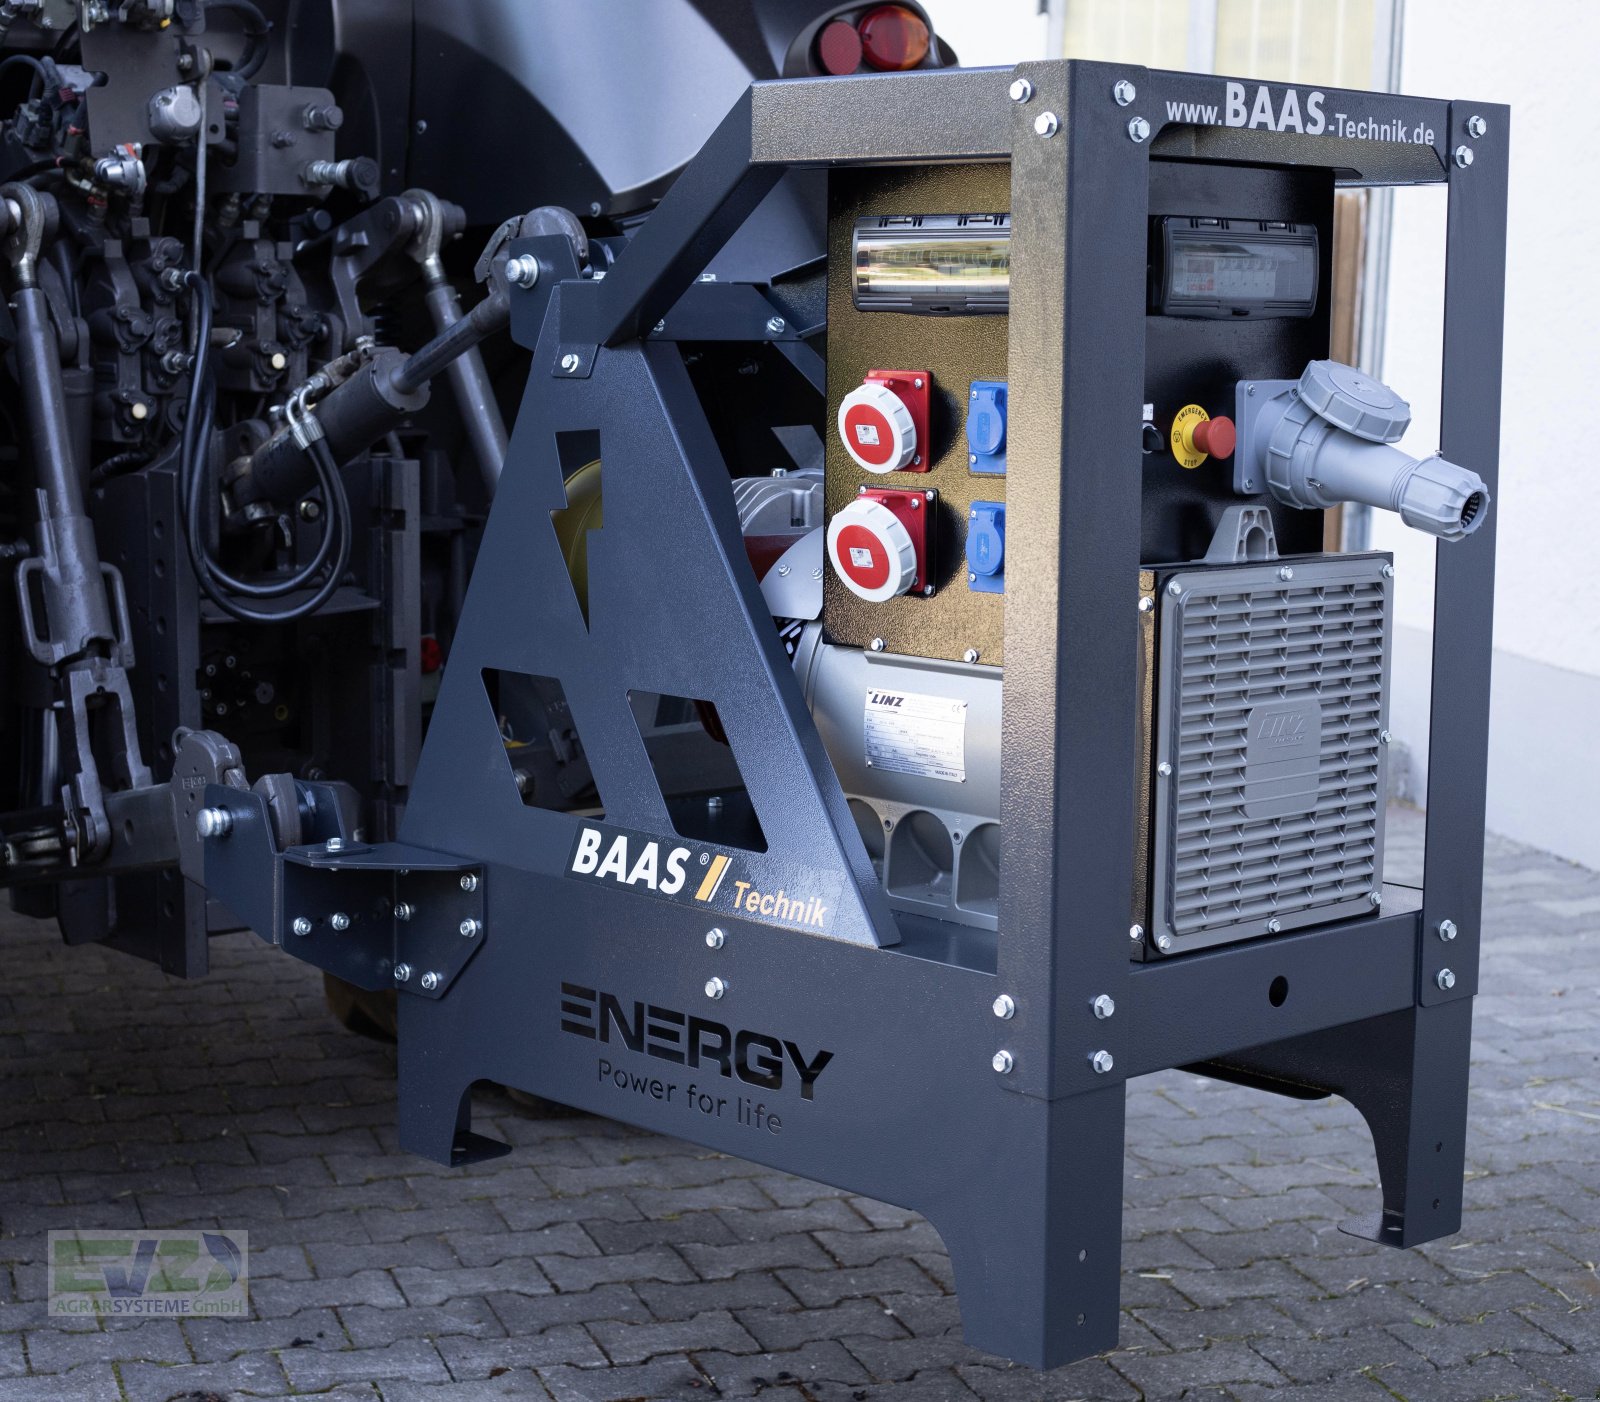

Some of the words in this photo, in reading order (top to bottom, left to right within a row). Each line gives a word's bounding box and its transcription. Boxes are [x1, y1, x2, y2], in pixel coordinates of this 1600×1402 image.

[1166, 82, 1434, 146] www.BAAS-Technik.de
[1178, 407, 1208, 422] EMERGENCY
[1184, 459, 1197, 467] STOP
[871, 693, 904, 707] LINZ
[572, 828, 691, 895] BAAS
[734, 880, 829, 928] Technik
[561, 981, 834, 1102] ENERGY
[598, 1058, 677, 1102] Power
[686, 1084, 727, 1118] for
[737, 1096, 783, 1135] life
